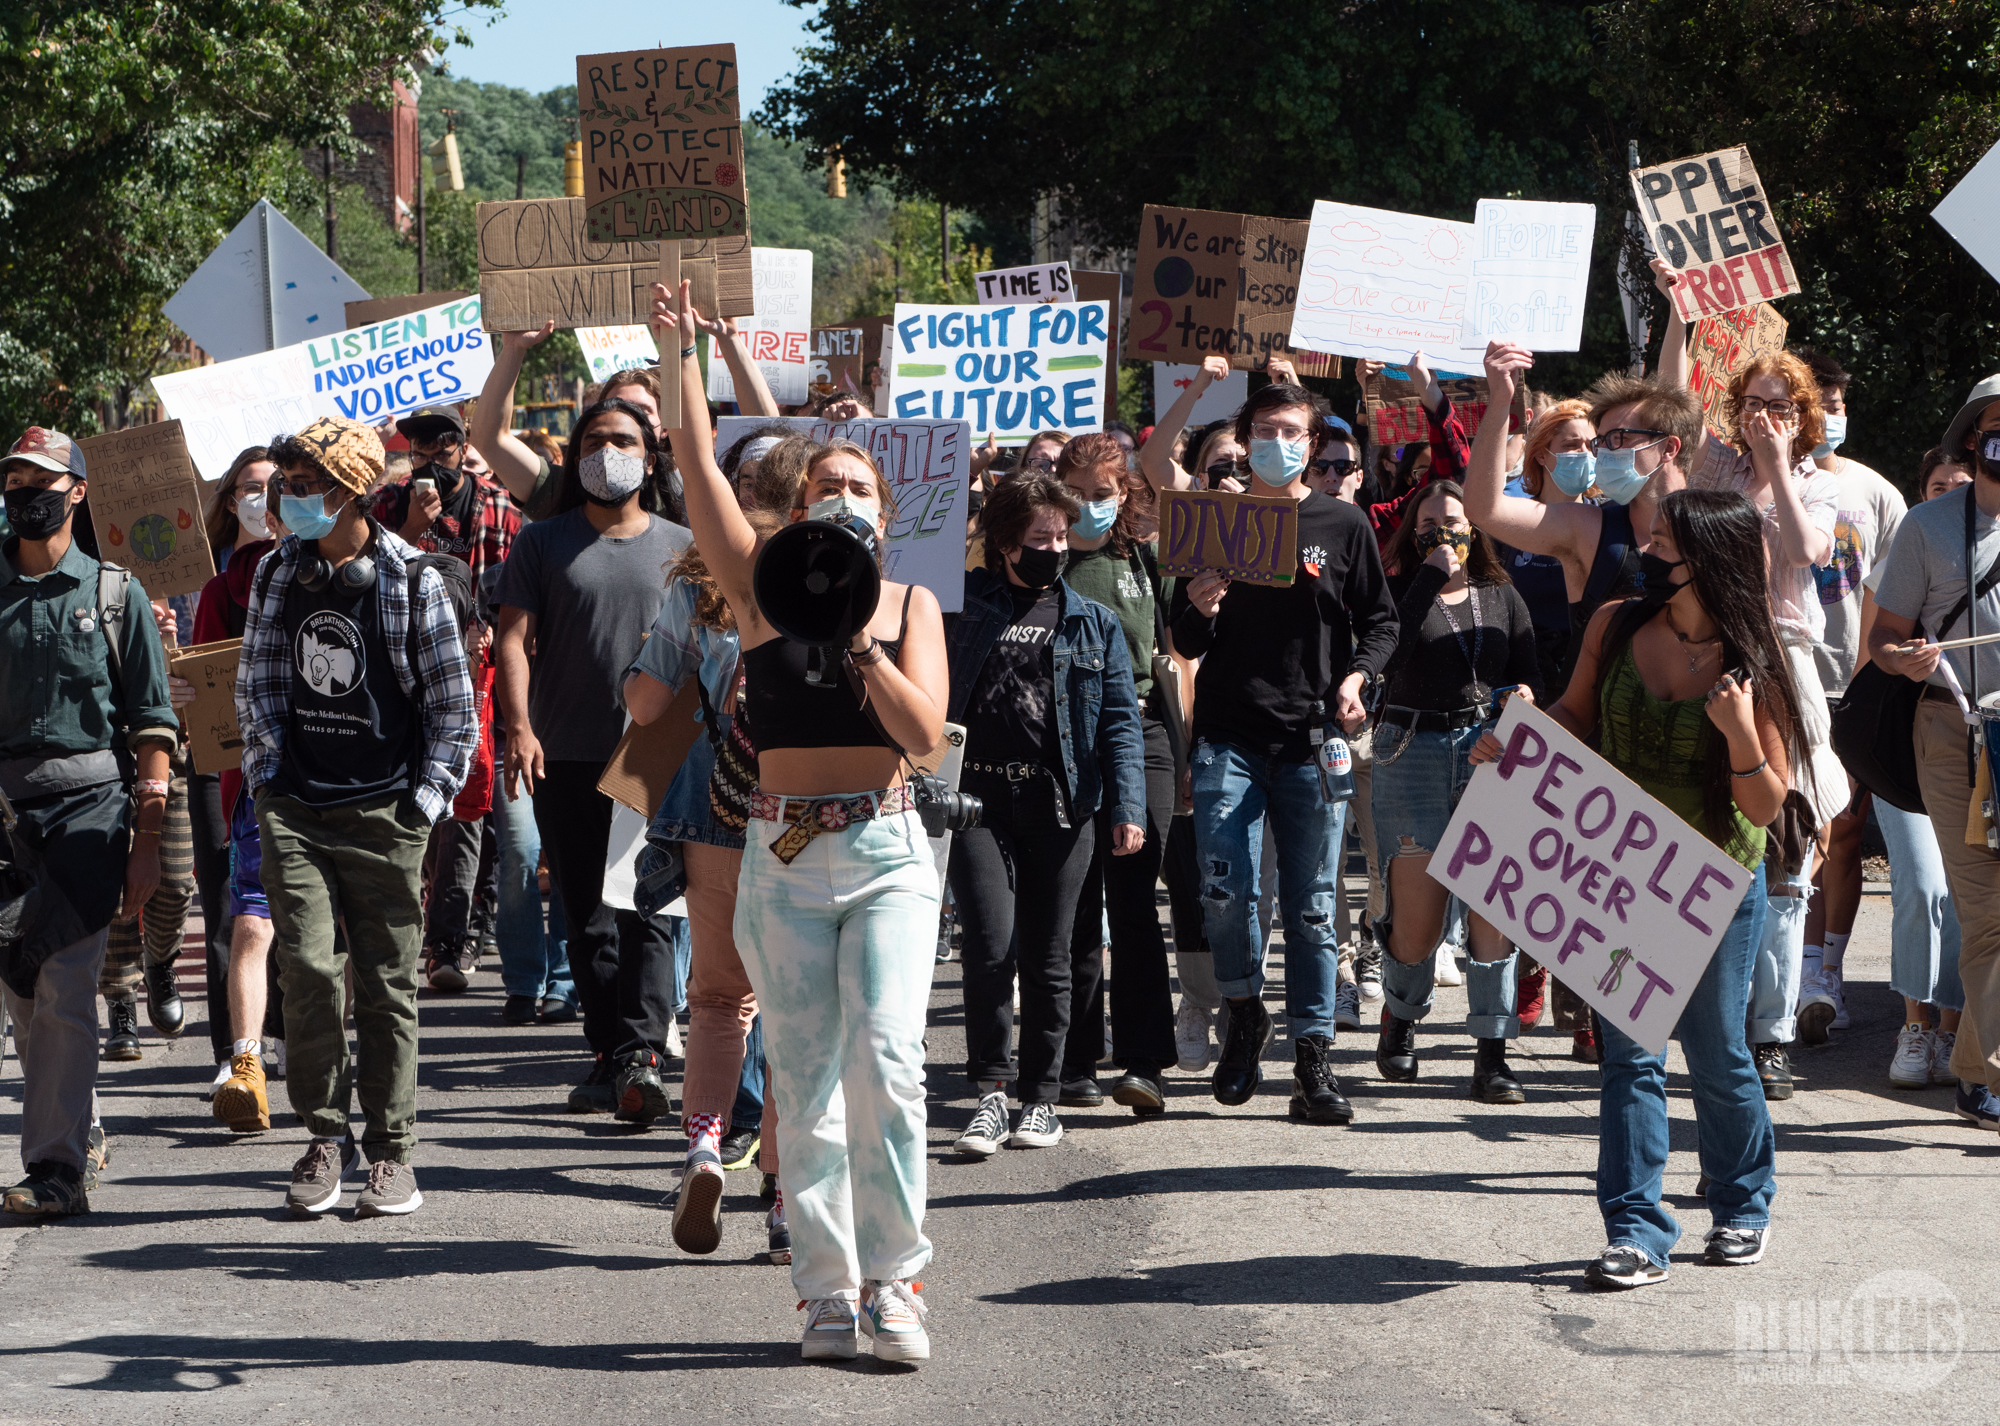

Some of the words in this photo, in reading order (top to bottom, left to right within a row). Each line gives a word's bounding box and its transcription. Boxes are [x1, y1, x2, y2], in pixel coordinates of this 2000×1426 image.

[589, 57, 734, 99] RESPECT
[644, 91, 659, 128] &
[590, 126, 739, 164] PROTECT
[598, 157, 711, 192] NATIVE
[1641, 157, 1756, 222] PPL
[613, 197, 732, 238] LAND
[1154, 214, 1199, 252] We
[1206, 236, 1245, 256] are
[1482, 204, 1582, 259] PEOPLE
[1655, 200, 1778, 269] OVER
[979, 271, 1040, 298] TIME
[1050, 266, 1069, 293] IS
[1304, 250, 1379, 306] Save
[1391, 296, 1430, 313] our
[1667, 244, 1789, 320] PROFIT
[308, 314, 427, 368] LISTEN
[440, 301, 481, 330] TO
[584, 326, 622, 352] Make
[761, 318, 780, 328] ON
[897, 306, 1016, 354] FIGHT
[1028, 304, 1108, 348] FOR
[1138, 300, 1173, 353] 2
[1175, 305, 1254, 355] teach
[1354, 322, 1383, 337] Stop
[1425, 329, 1451, 341] Change
[314, 328, 483, 393] INDIGENOUS
[955, 350, 1041, 384] OUR
[163, 370, 258, 414] THERE
[251, 365, 280, 396] IS
[334, 360, 461, 419] VOICES
[895, 378, 1097, 432] FUTURE
[85, 442, 113, 461] THE
[116, 427, 179, 453] GREATEST
[190, 396, 310, 461] PLANET
[90, 457, 144, 481] THREAT
[150, 452, 169, 464] TO
[97, 479, 127, 497] THE
[134, 465, 183, 489] PLANET
[97, 503, 113, 516] IS
[117, 495, 139, 511] THE
[143, 485, 187, 506] BELIEF
[1167, 498, 1292, 571] DIVEST
[1302, 545, 1328, 558] HIGH
[134, 550, 182, 570] SOMEONE
[182, 541, 205, 554] ELSE
[1303, 556, 1326, 565] DIVE
[150, 571, 177, 586] FIX
[182, 562, 201, 578] IT
[310, 616, 359, 648] BREAKTHROUGH
[210, 721, 229, 735] And
[303, 724, 325, 733] CLASS
[319, 710, 341, 719] Mellon
[342, 712, 372, 728] University
[1324, 743, 1345, 752] FEEL
[1326, 751, 1347, 761] THE
[1327, 760, 1349, 768] BERN
[1496, 721, 1735, 936] PEOPLE
[1529, 827, 1636, 923] OVER
